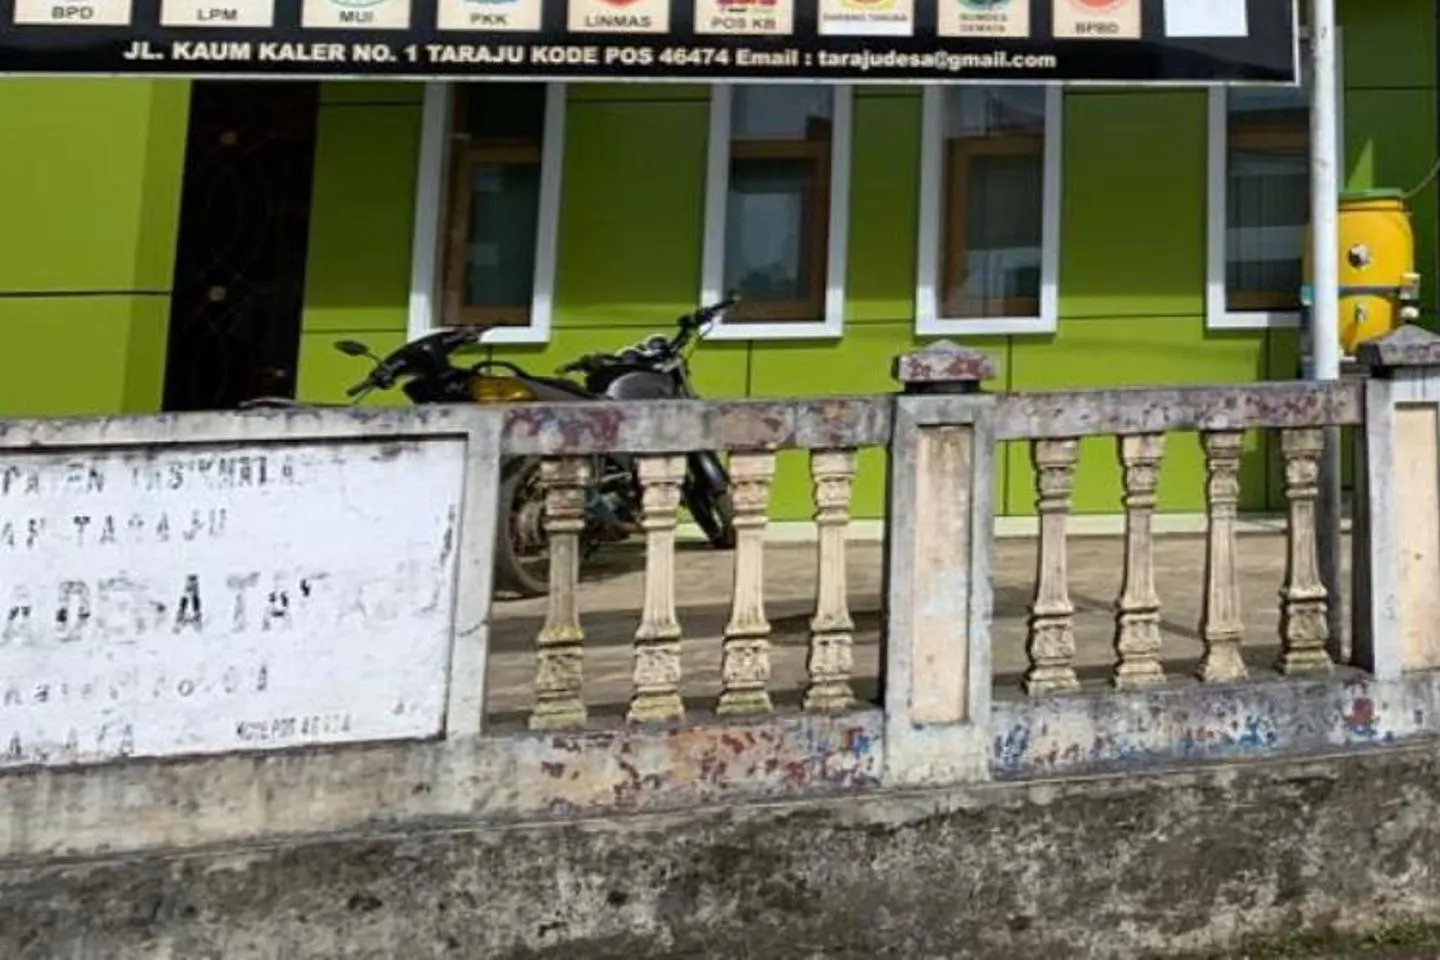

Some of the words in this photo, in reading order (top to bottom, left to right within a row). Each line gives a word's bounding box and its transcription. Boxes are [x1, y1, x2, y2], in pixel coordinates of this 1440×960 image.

[51, 6, 94, 19] BPD
[197, 8, 238, 20] LPM
[470, 13, 509, 26] PKK
[585, 15, 652, 27] LINMAS
[711, 17, 747, 29] POS
[124, 41, 163, 59] JL.
[172, 42, 250, 60] KAUM
[259, 43, 345, 61] KALER
[352, 45, 396, 61] NO.
[404, 45, 417, 61] 1
[426, 45, 523, 62] TARAJU
[531, 46, 598, 64] KODE
[605, 47, 653, 65] POS
[659, 47, 728, 66] 46474
[735, 48, 798, 66] Email
[817, 50, 1057, 71] tarajudesa@gmail.com
